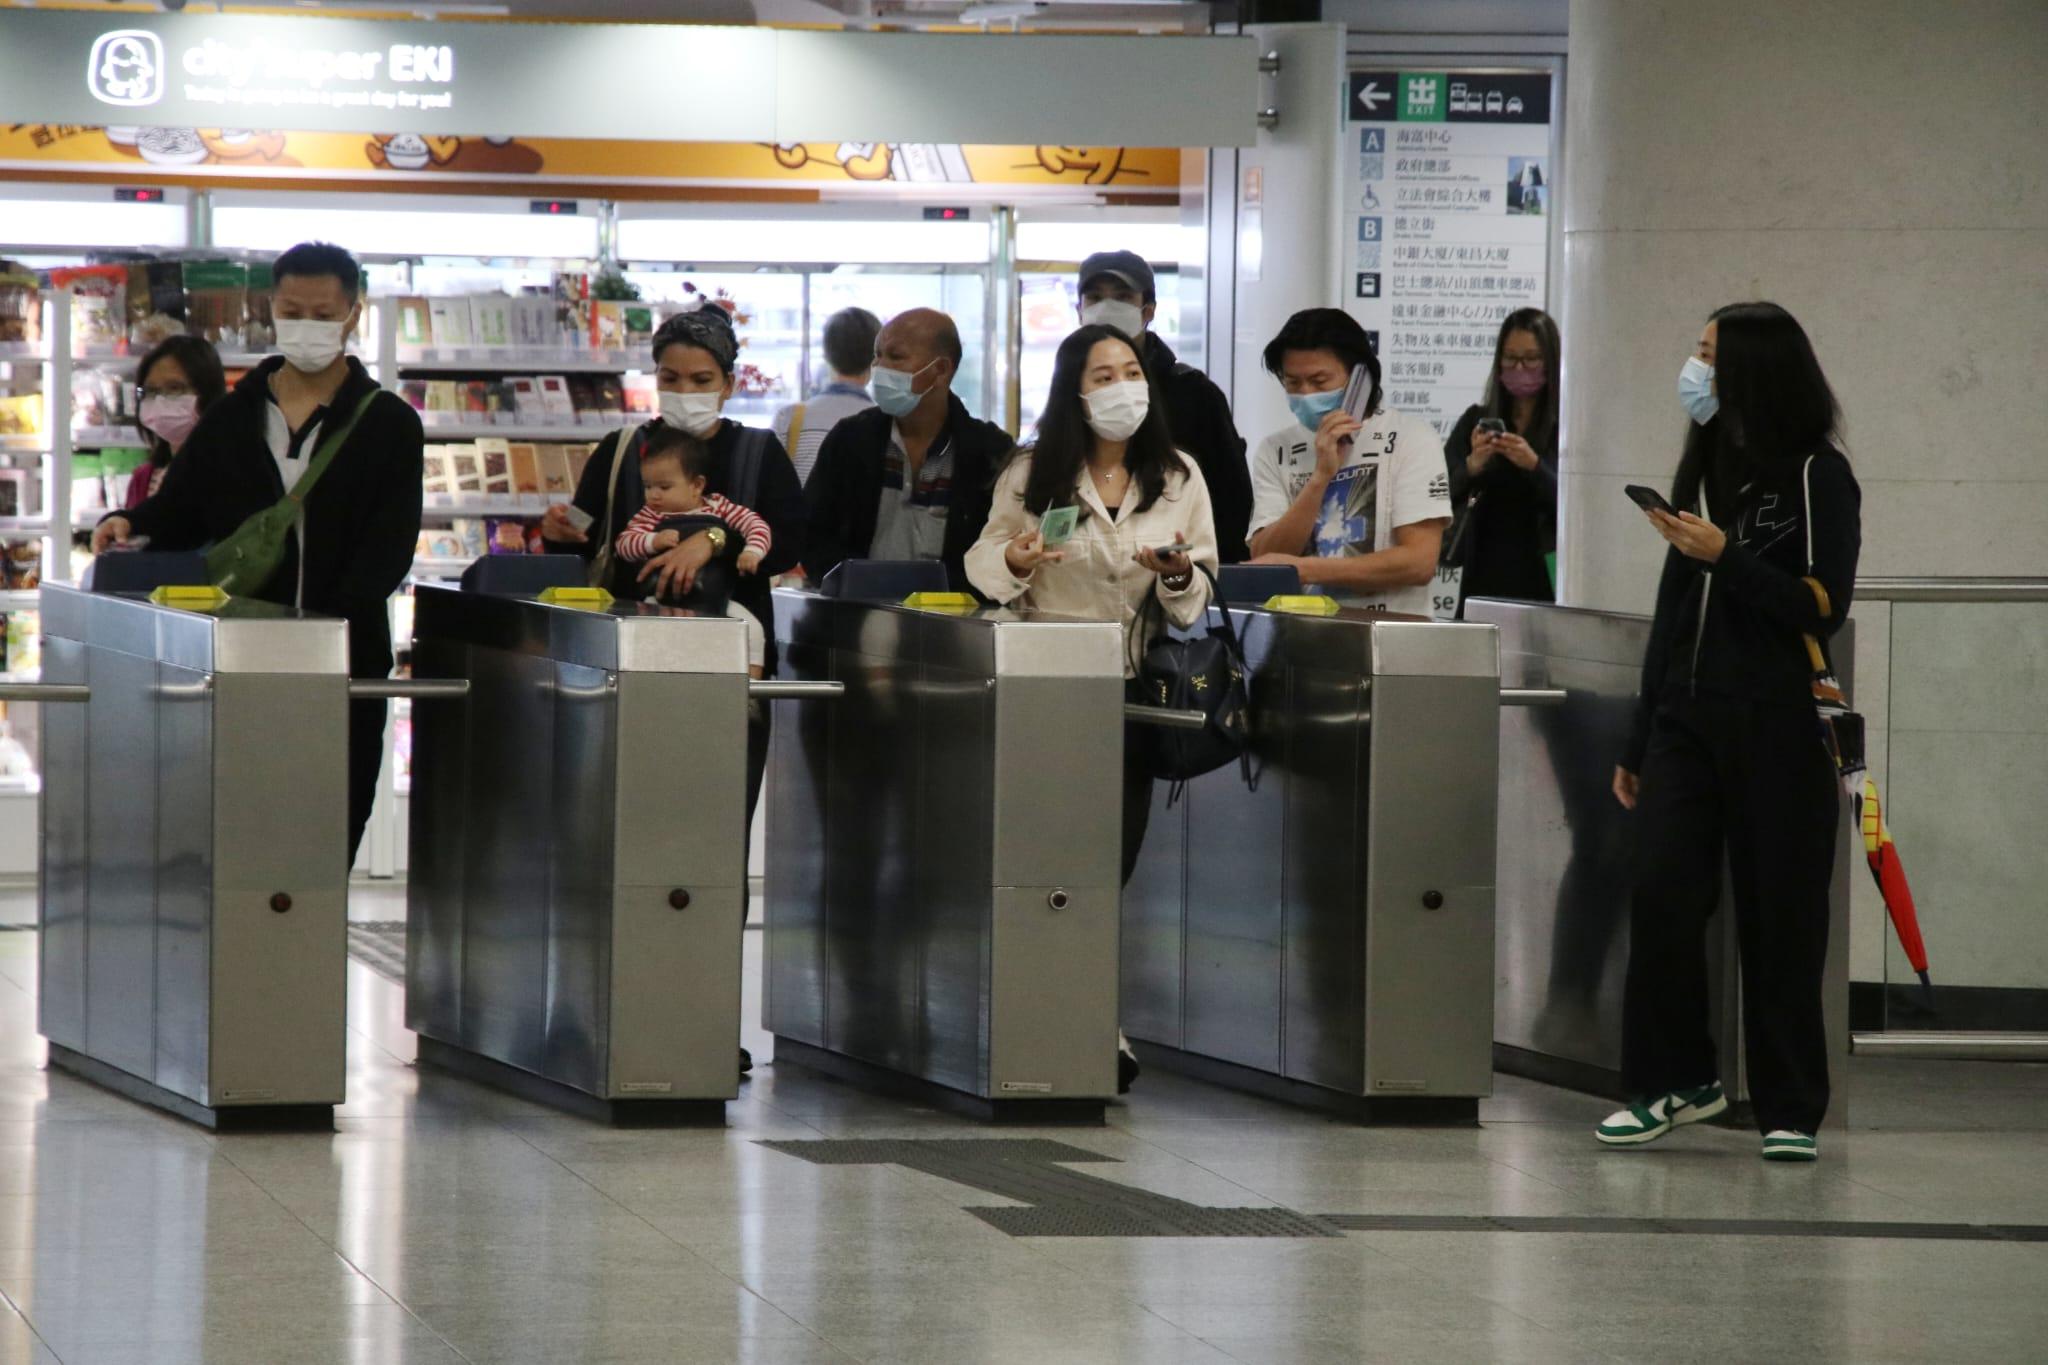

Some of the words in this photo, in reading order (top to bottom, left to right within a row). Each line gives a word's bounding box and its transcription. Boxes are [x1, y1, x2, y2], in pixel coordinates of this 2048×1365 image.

[390, 45, 452, 81] EKI
[1408, 104, 1434, 115] EXIT
[1366, 132, 1379, 149] A
[1396, 128, 1452, 144] 海富中心
[1395, 158, 1451, 173] 政府總部
[1365, 220, 1376, 239] B
[1384, 431, 1397, 453] 3
